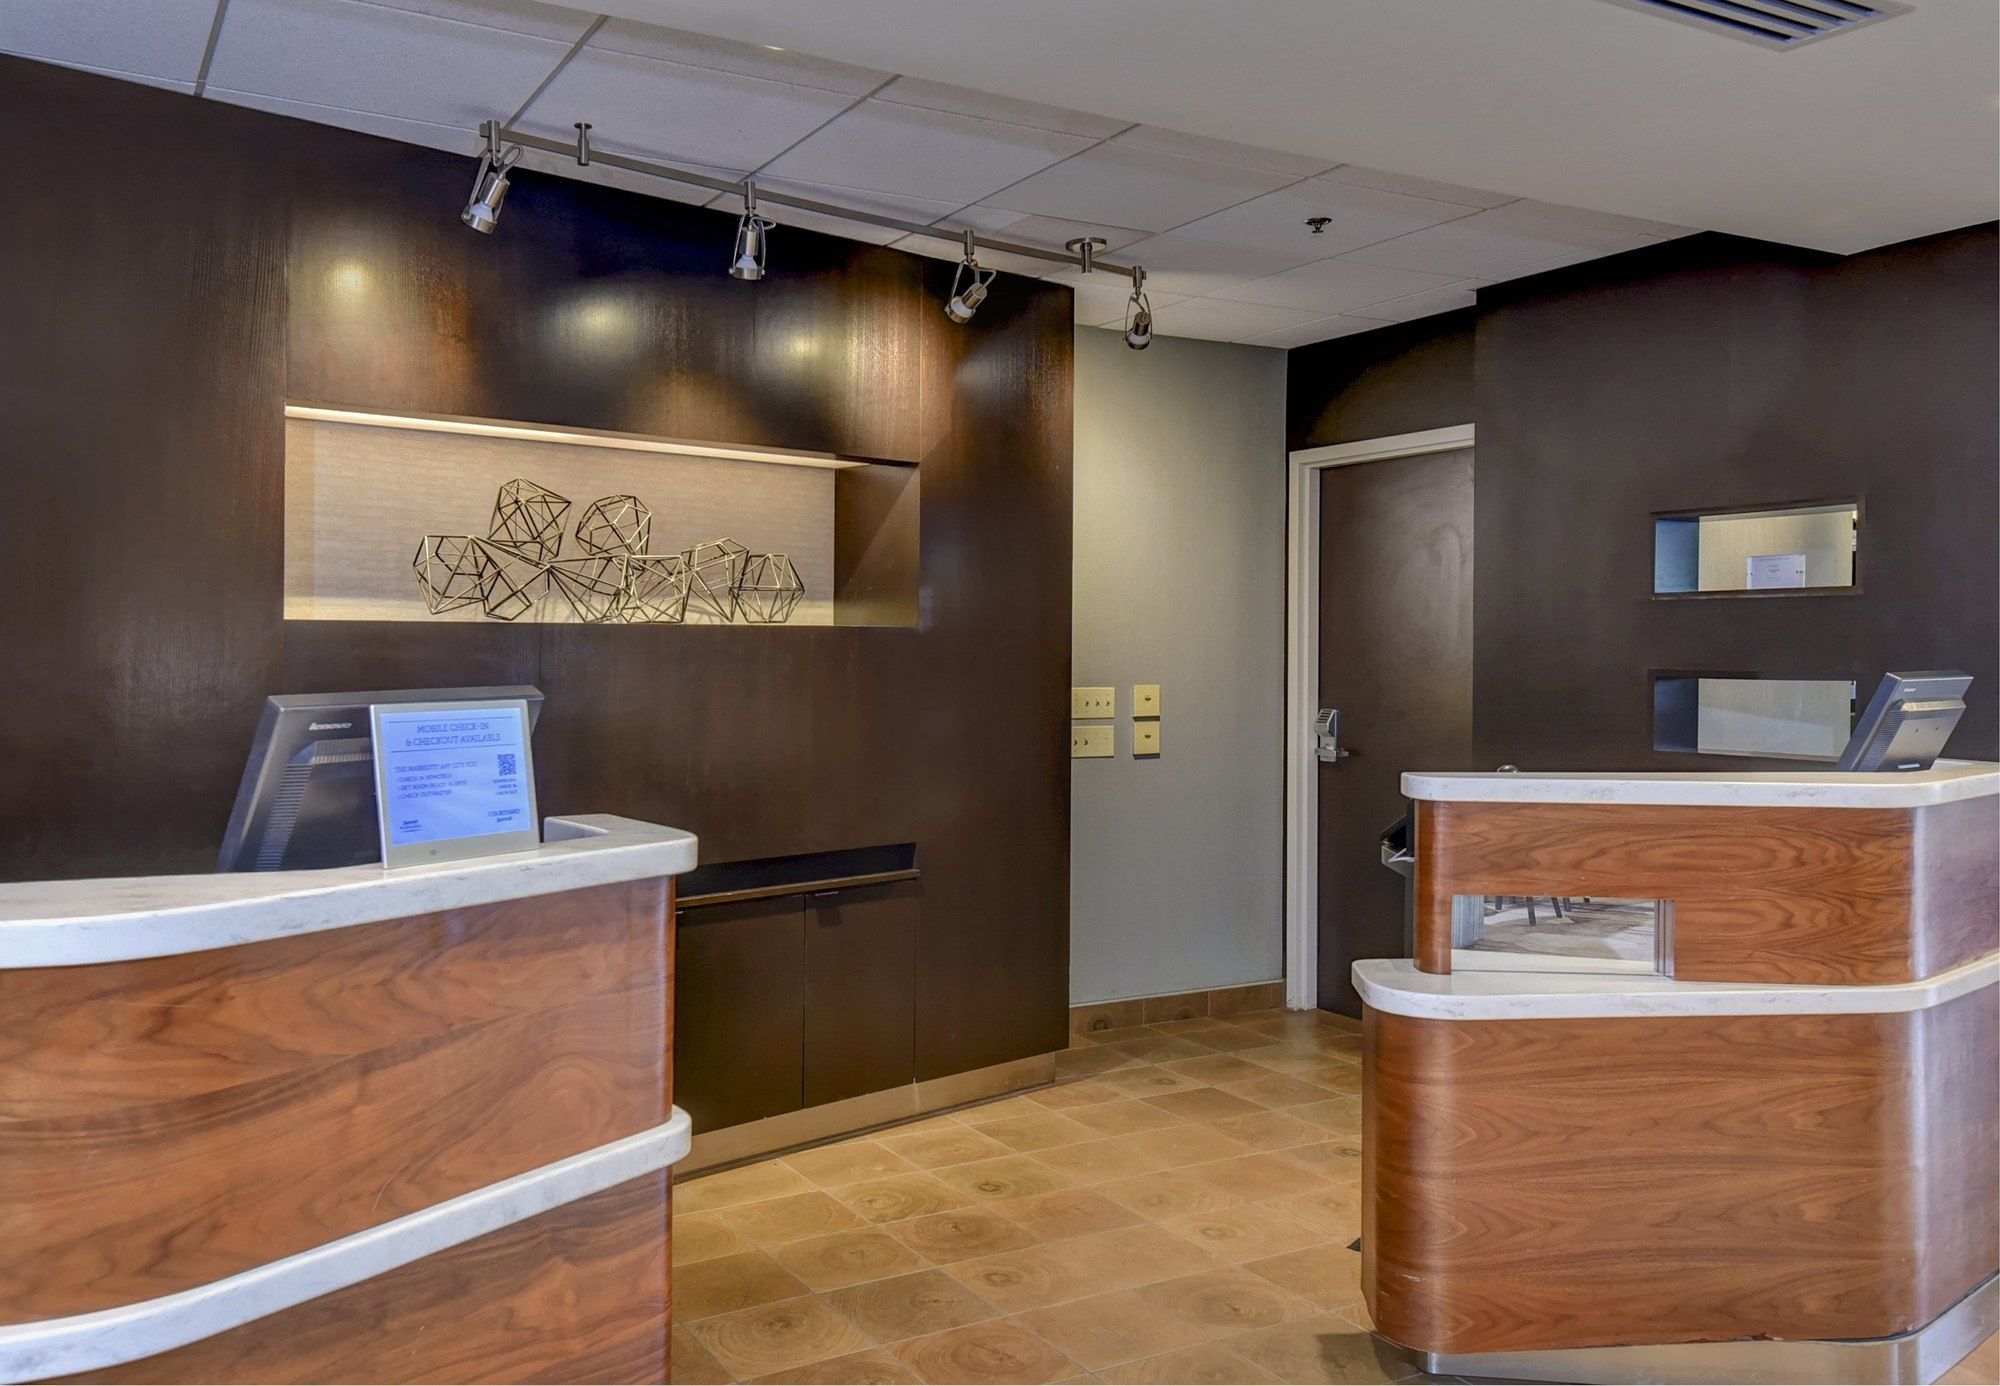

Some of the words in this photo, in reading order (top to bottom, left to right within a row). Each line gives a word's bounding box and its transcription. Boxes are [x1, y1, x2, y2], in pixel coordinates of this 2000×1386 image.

[417, 724, 448, 733] MOBILE
[450, 722, 489, 732] CHECK-IN
[413, 736, 459, 746] CHECKOUT
[461, 733, 502, 744] AVAILABLE
